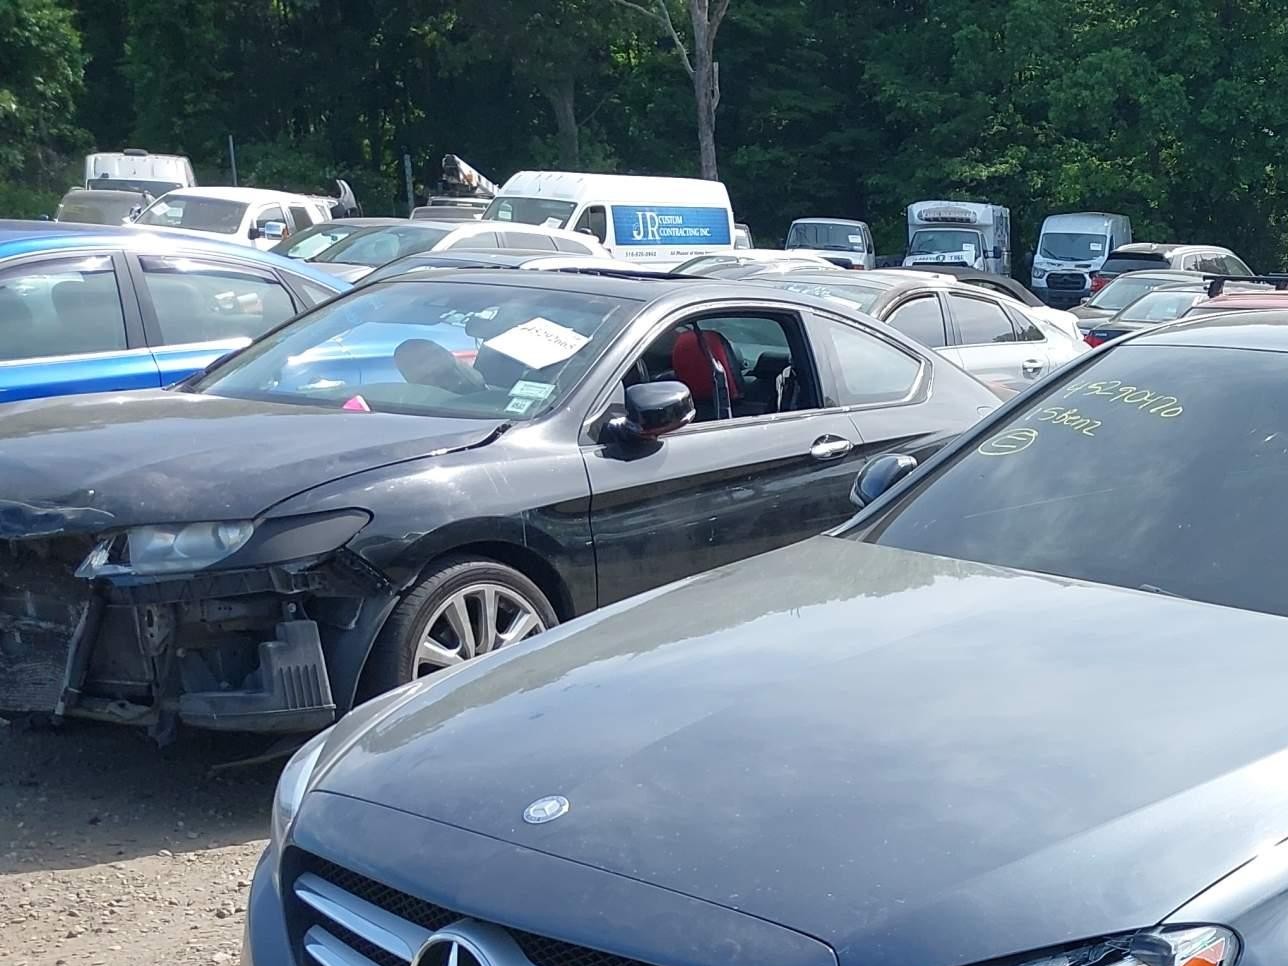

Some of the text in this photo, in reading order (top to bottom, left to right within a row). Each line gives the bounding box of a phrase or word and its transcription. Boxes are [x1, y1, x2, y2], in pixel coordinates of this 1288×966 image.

[632, 211, 661, 240] JR
[658, 215, 682, 225] CUSTOM
[660, 227, 699, 237] CONTRACTING
[1063, 380, 1184, 418] 45290470
